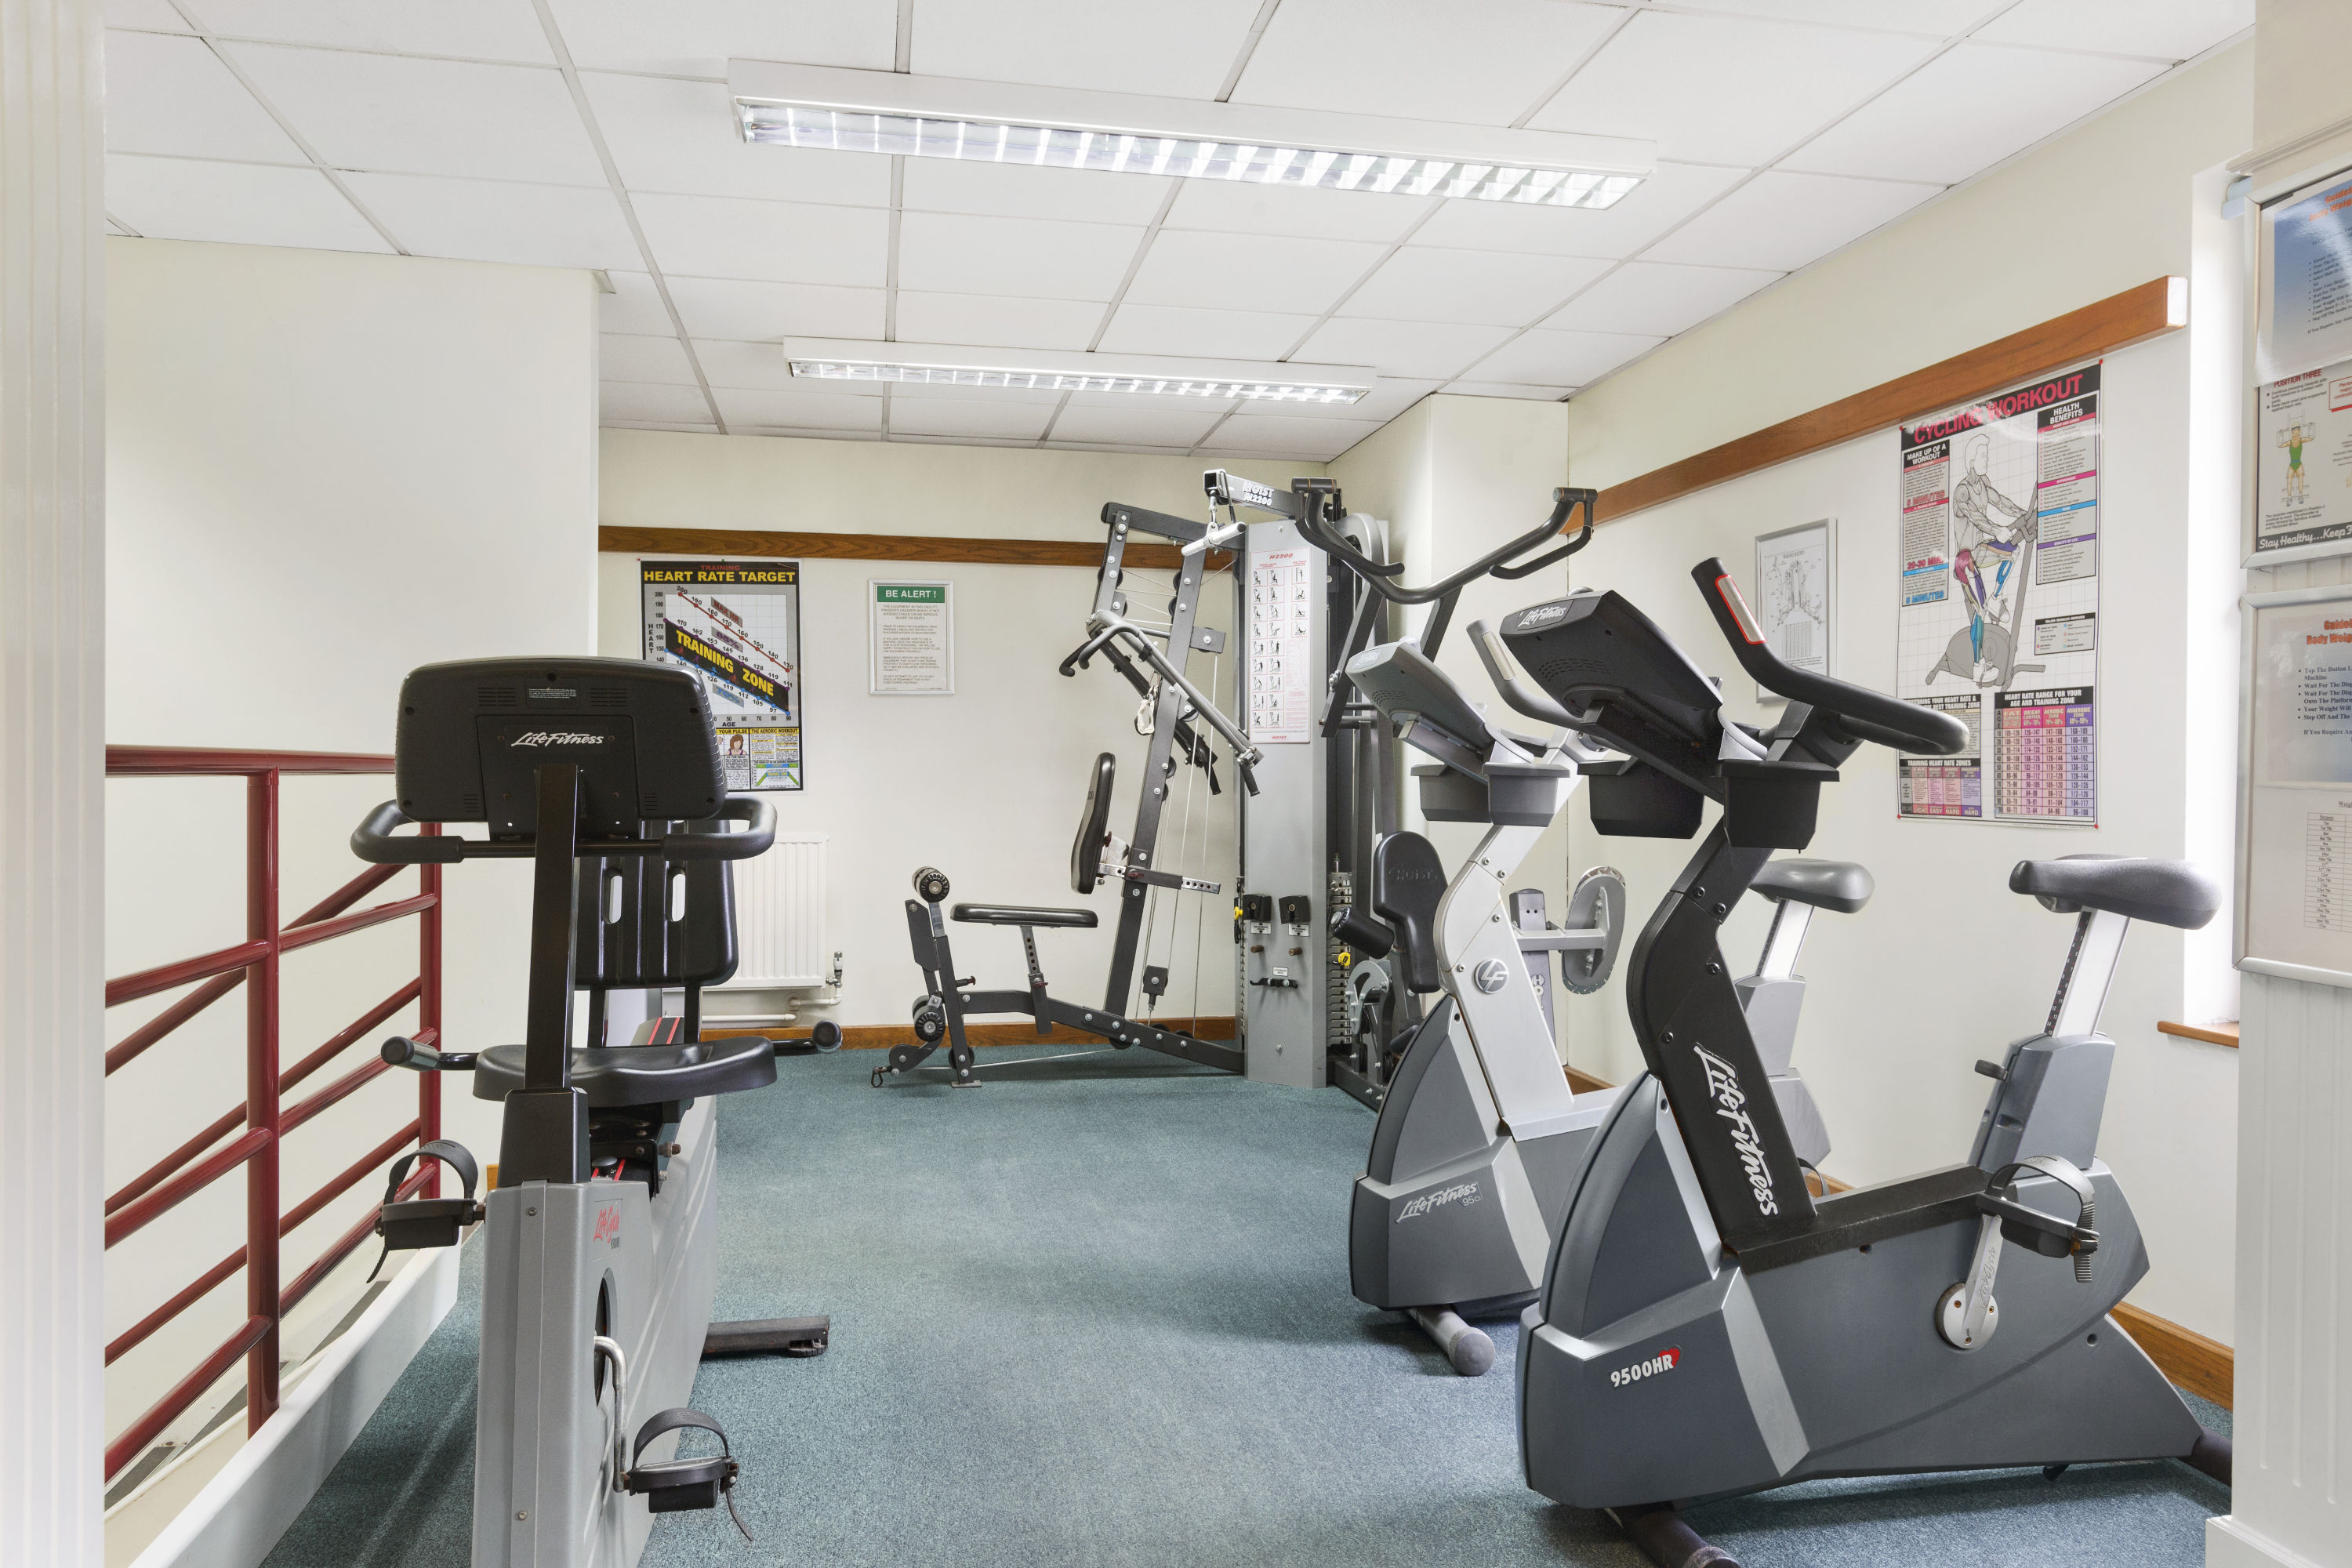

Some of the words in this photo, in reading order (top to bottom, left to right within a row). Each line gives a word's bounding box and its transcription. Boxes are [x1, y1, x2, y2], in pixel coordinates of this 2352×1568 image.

[2274, 376, 2301, 388] POSITION
[2303, 368, 2321, 381] THREE
[1914, 407, 1983, 445] CYCLING
[1987, 373, 2083, 422] WORKOUT
[2053, 401, 2080, 416] HEALTH
[2050, 408, 2083, 425] BENEFITS
[1907, 452, 1923, 461] MAKE
[1912, 452, 1941, 466] WORKOUT
[1243, 481, 1275, 498] HOIST
[1244, 491, 1272, 506] H2200
[1913, 489, 1945, 506] MINUTES
[2259, 538, 2279, 550] Stay
[1907, 558, 1926, 571] 20-30
[644, 571, 693, 582] HEART
[698, 571, 735, 582] RATE
[739, 571, 795, 583] TARGET
[677, 585, 688, 594] 200
[901, 590, 931, 598] ALERT
[691, 597, 702, 605] 190
[1912, 590, 1944, 604] MINUTES
[707, 608, 718, 616] 180
[738, 629, 749, 638] 160
[2307, 633, 2328, 645] Body
[753, 640, 764, 649] 150
[768, 650, 779, 659] 140
[676, 630, 734, 674] TRAINING
[742, 668, 775, 697] ZONE
[783, 661, 793, 670] 130
[1610, 1354, 1675, 1388] 9500HR
